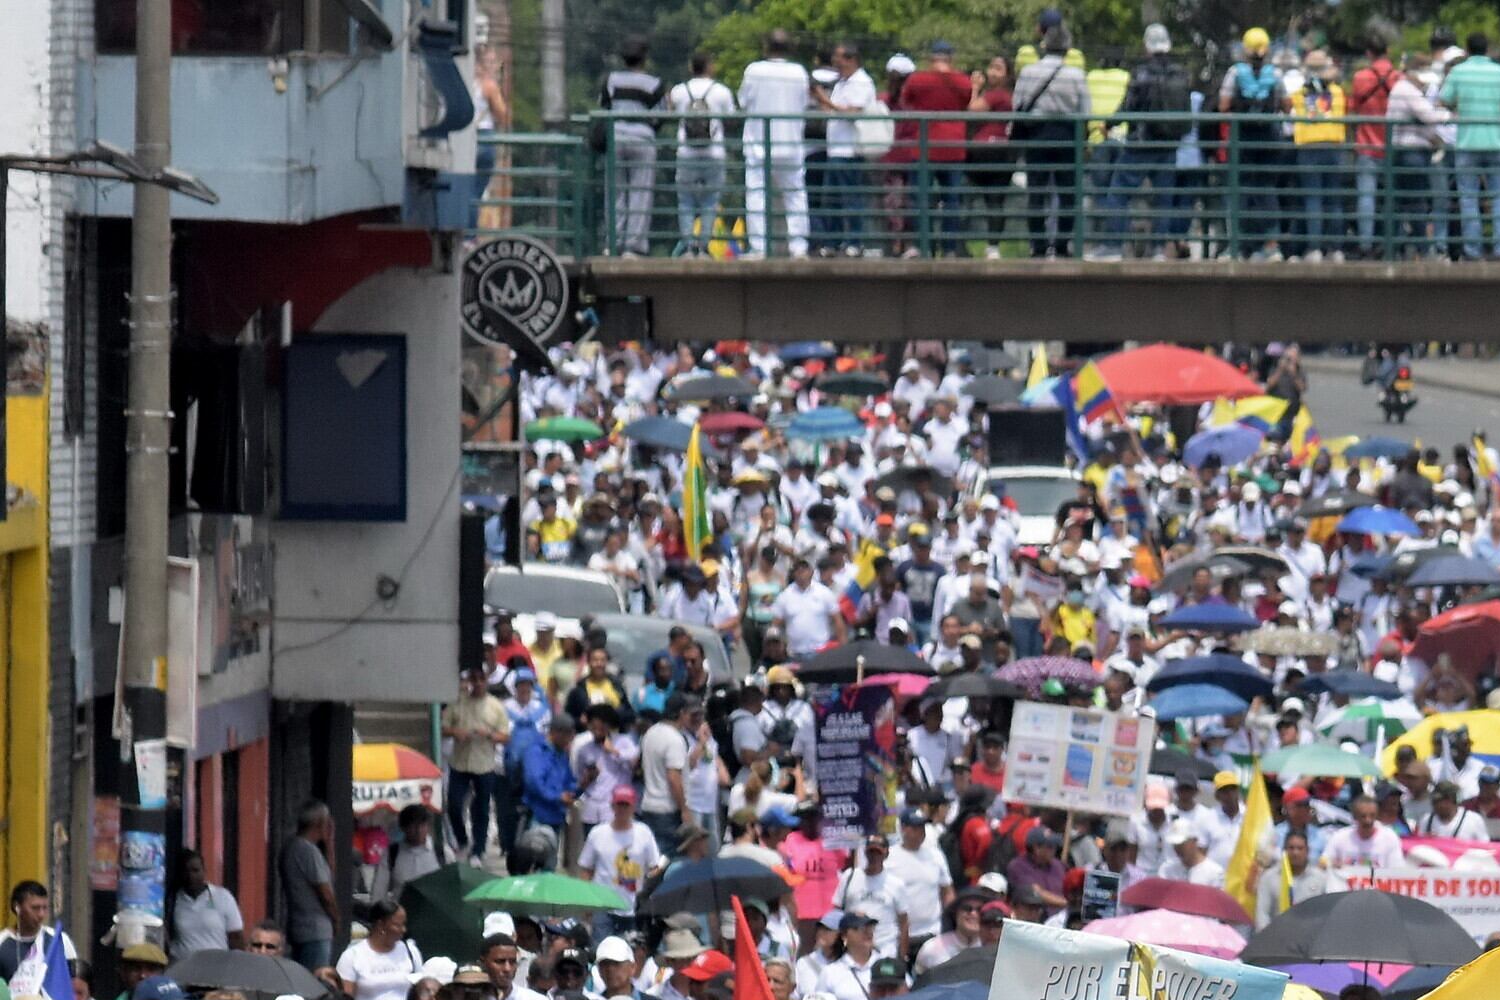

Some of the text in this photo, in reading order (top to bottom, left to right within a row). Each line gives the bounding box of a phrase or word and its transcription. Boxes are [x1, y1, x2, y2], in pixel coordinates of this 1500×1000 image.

[468, 241, 552, 274] LICORES
[352, 786, 411, 800] RUTAS
[1434, 879, 1460, 897] DE
